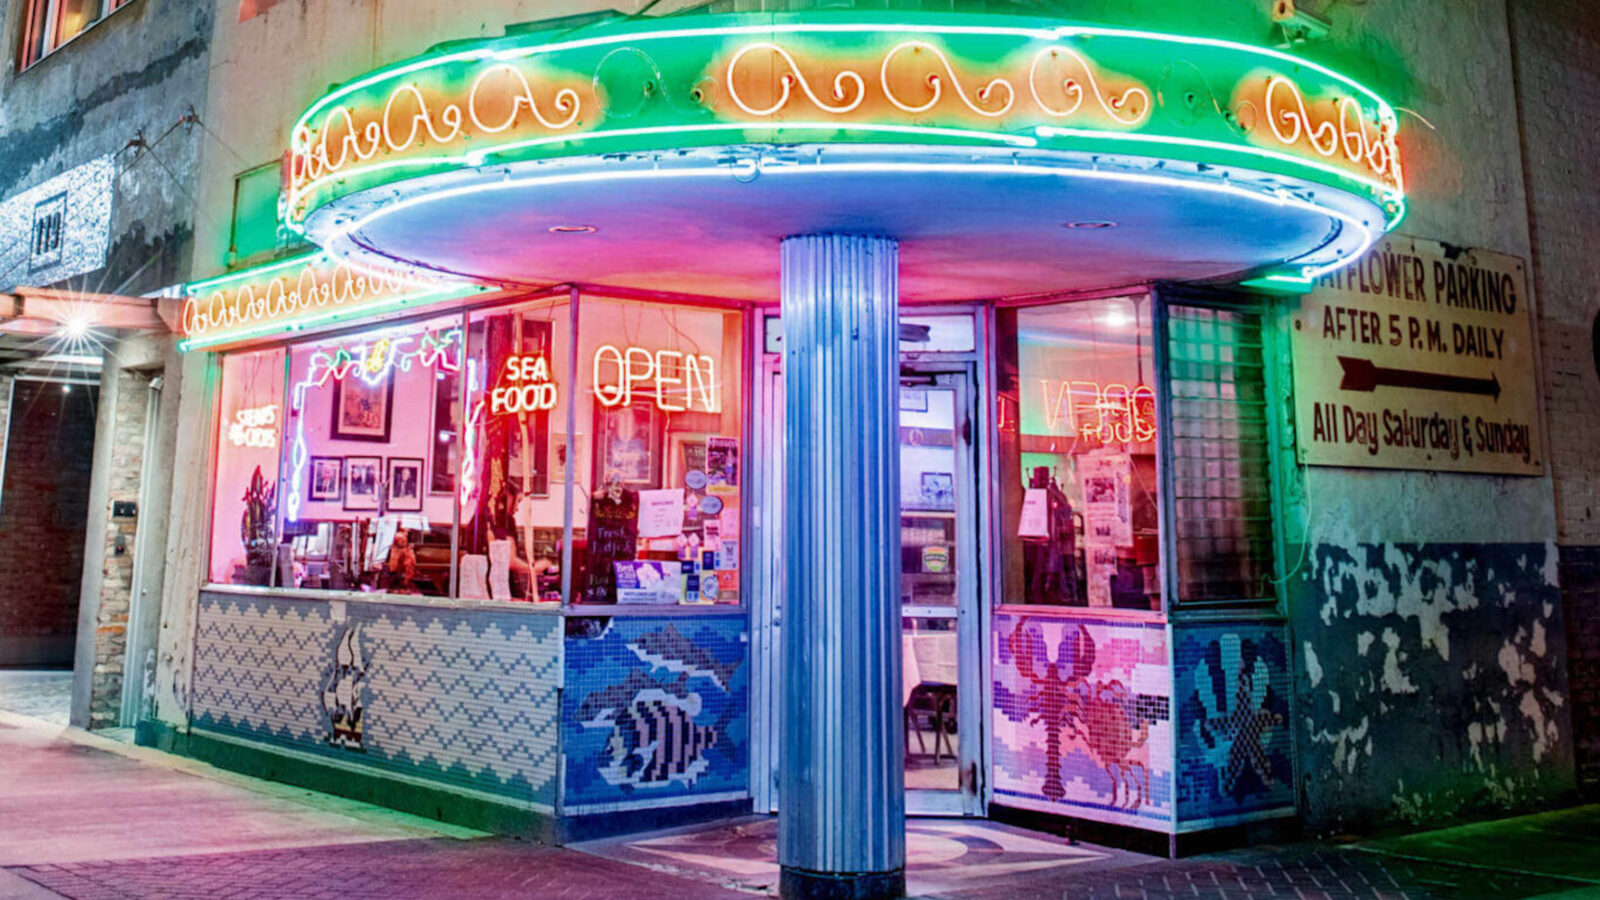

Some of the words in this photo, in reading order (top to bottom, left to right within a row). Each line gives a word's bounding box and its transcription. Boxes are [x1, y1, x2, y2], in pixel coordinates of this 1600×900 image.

[1313, 247, 1427, 303] AYFLOWER
[1434, 258, 1517, 315] PARKING
[1323, 305, 1383, 346] AFTER
[1389, 315, 1402, 346] 5
[1453, 323, 1504, 360] DAILY
[505, 355, 549, 381] SEA
[593, 344, 715, 413] OPEN
[490, 383, 557, 414] FOOD
[1313, 402, 1338, 443] All
[1344, 406, 1378, 456] Day
[1383, 408, 1460, 460] Saturday
[1462, 418, 1473, 456] &
[1475, 420, 1530, 463] Sunday
